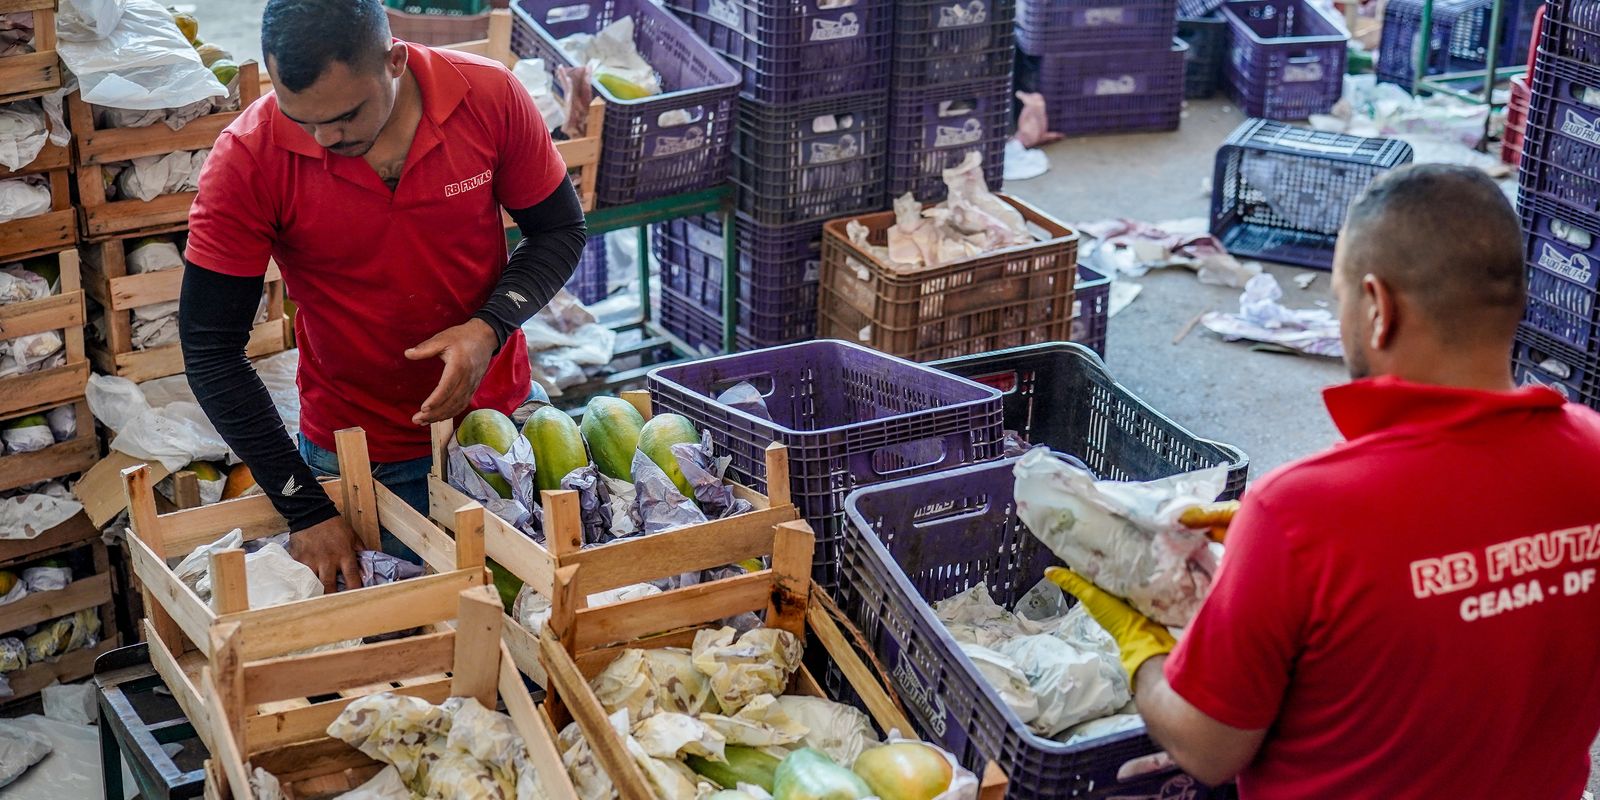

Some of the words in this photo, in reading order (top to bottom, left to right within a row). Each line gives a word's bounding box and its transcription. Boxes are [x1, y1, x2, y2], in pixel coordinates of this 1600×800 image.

[1581, 129, 1600, 144] FRUT
[445, 183, 460, 198] RB
[460, 169, 492, 193] FRUTAS
[1410, 552, 1478, 599] RB
[1460, 579, 1544, 622] CEASA
[1563, 568, 1597, 597] DF
